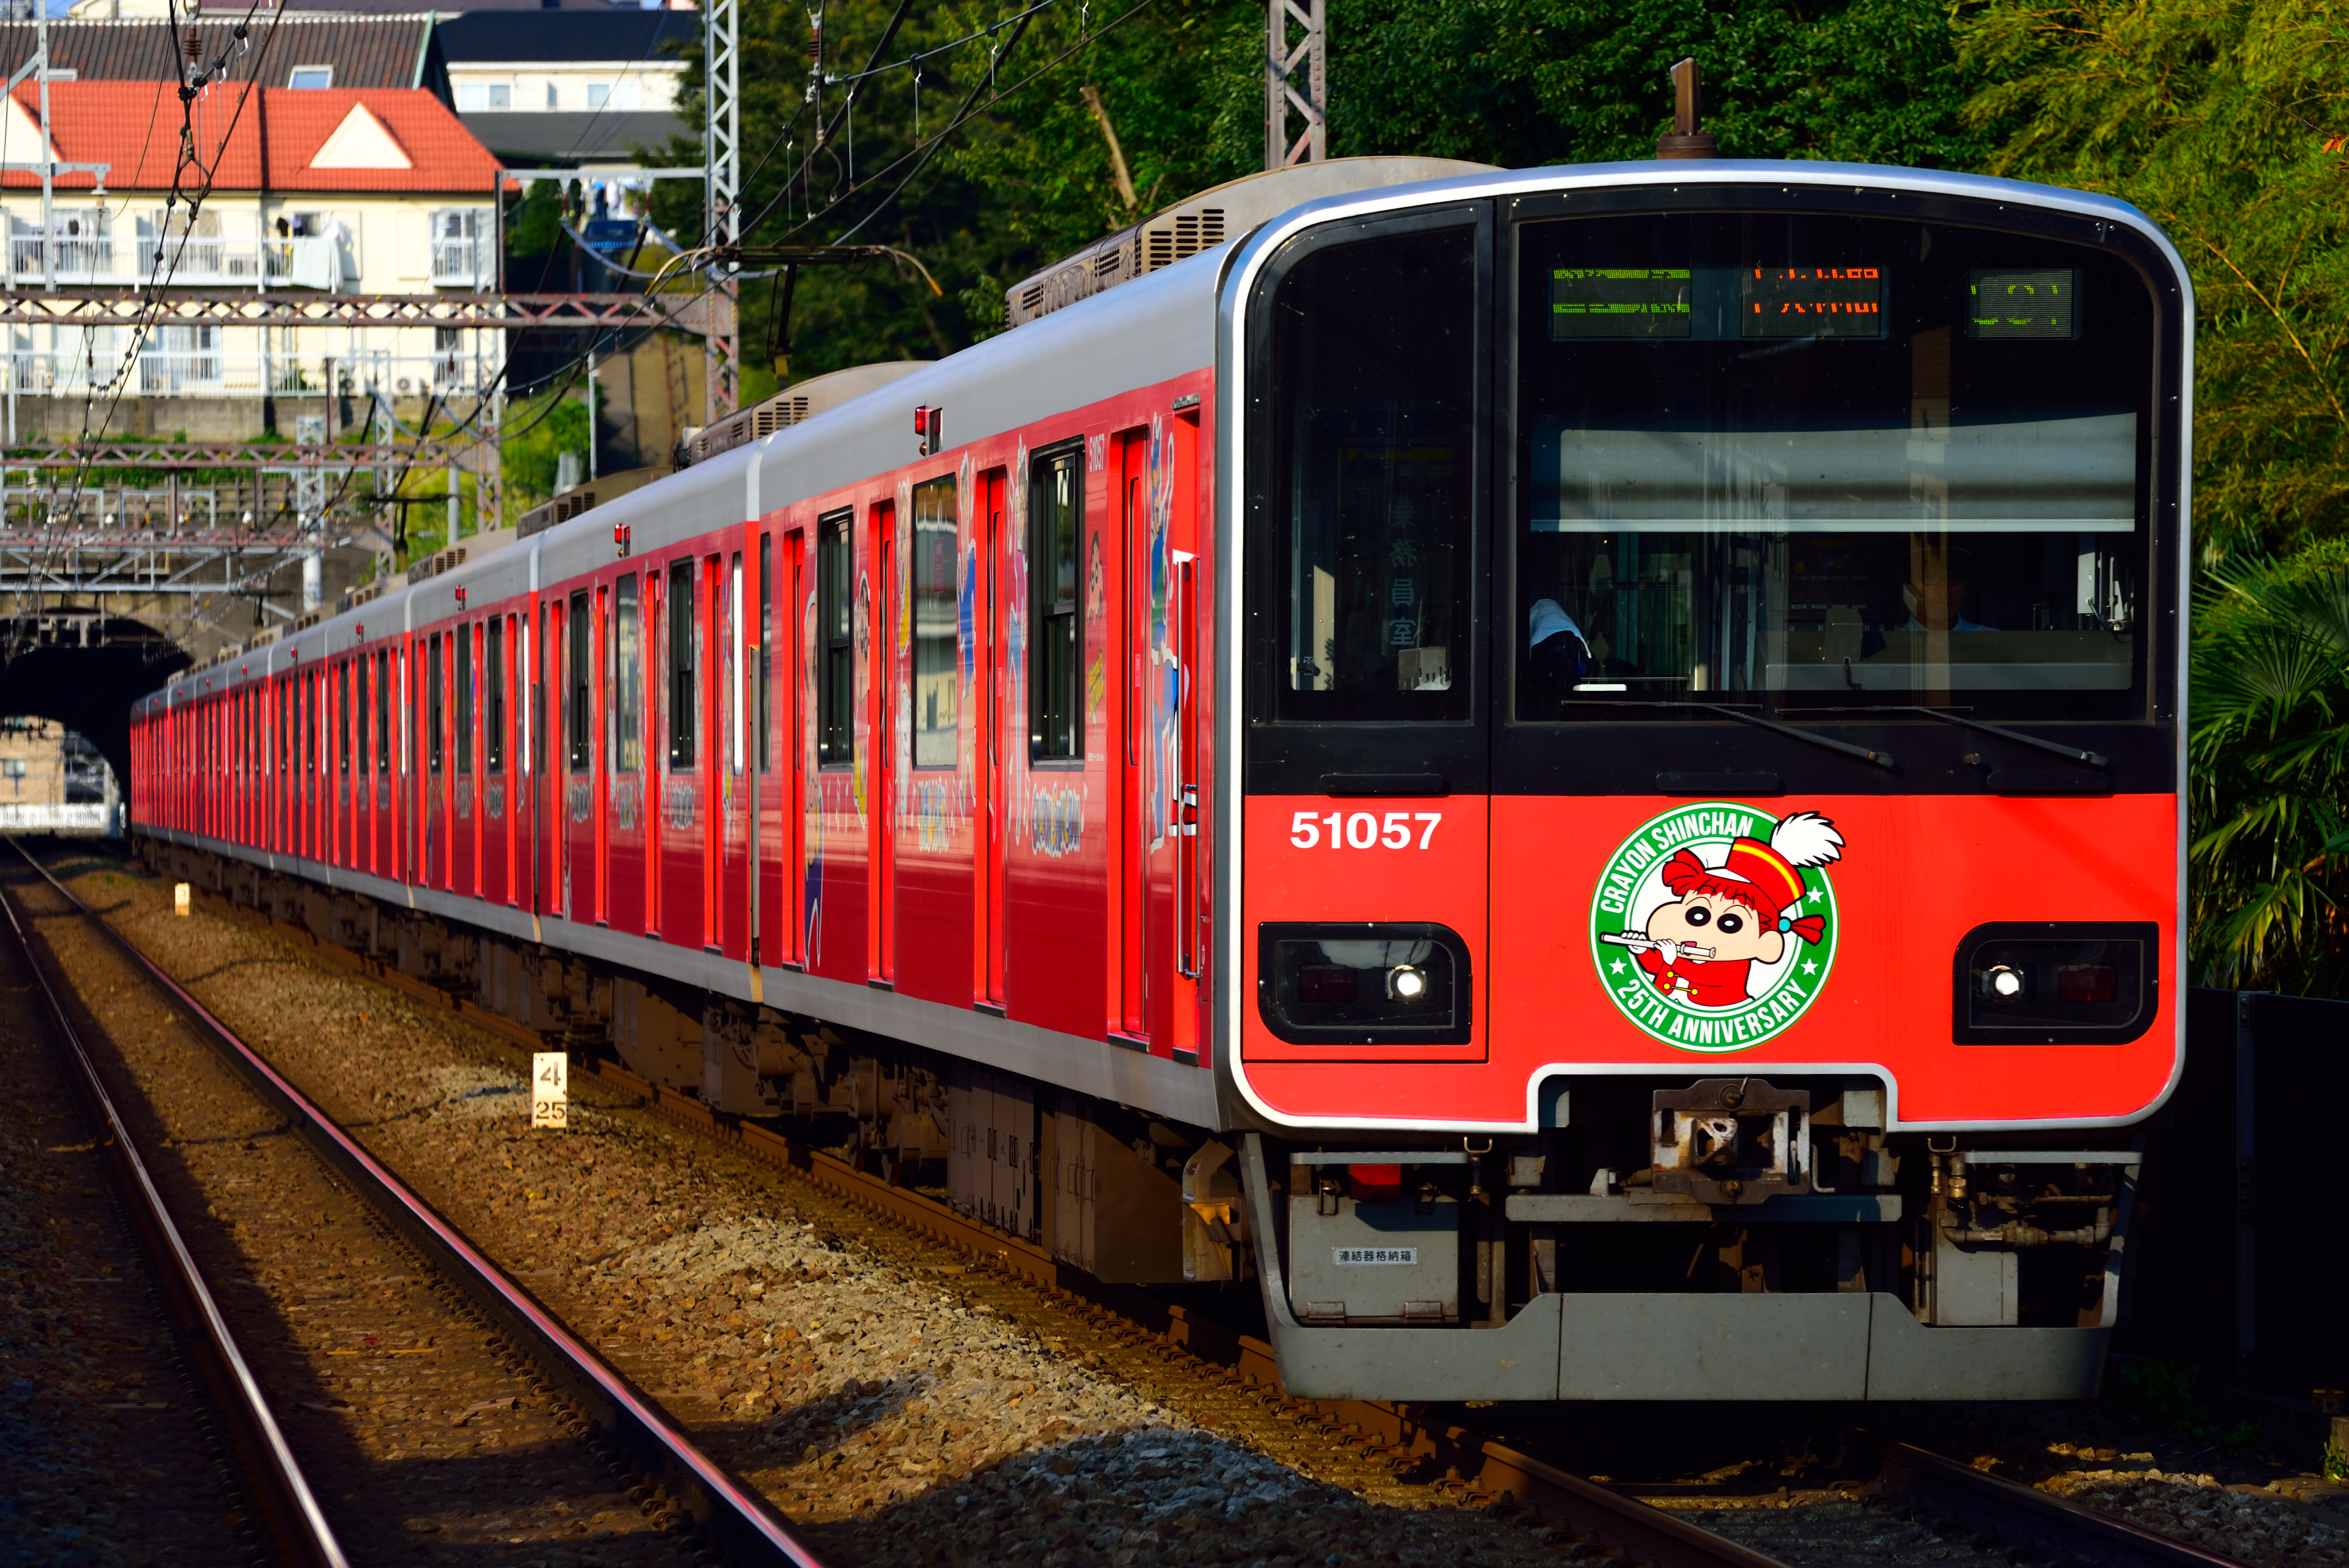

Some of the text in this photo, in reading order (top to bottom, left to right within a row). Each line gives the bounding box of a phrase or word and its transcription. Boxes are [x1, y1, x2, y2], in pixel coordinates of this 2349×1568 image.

[1089, 434, 1105, 472] 51057
[1290, 812, 1442, 849] 51057
[1600, 812, 1754, 913] CRAYON SHINCHAN
[1617, 979, 1807, 1043] 25TH ANNIVERSARY
[540, 1062, 561, 1086] 4
[536, 1101, 566, 1120] 25
[1339, 1251, 1411, 1261] 連結器格納箱
